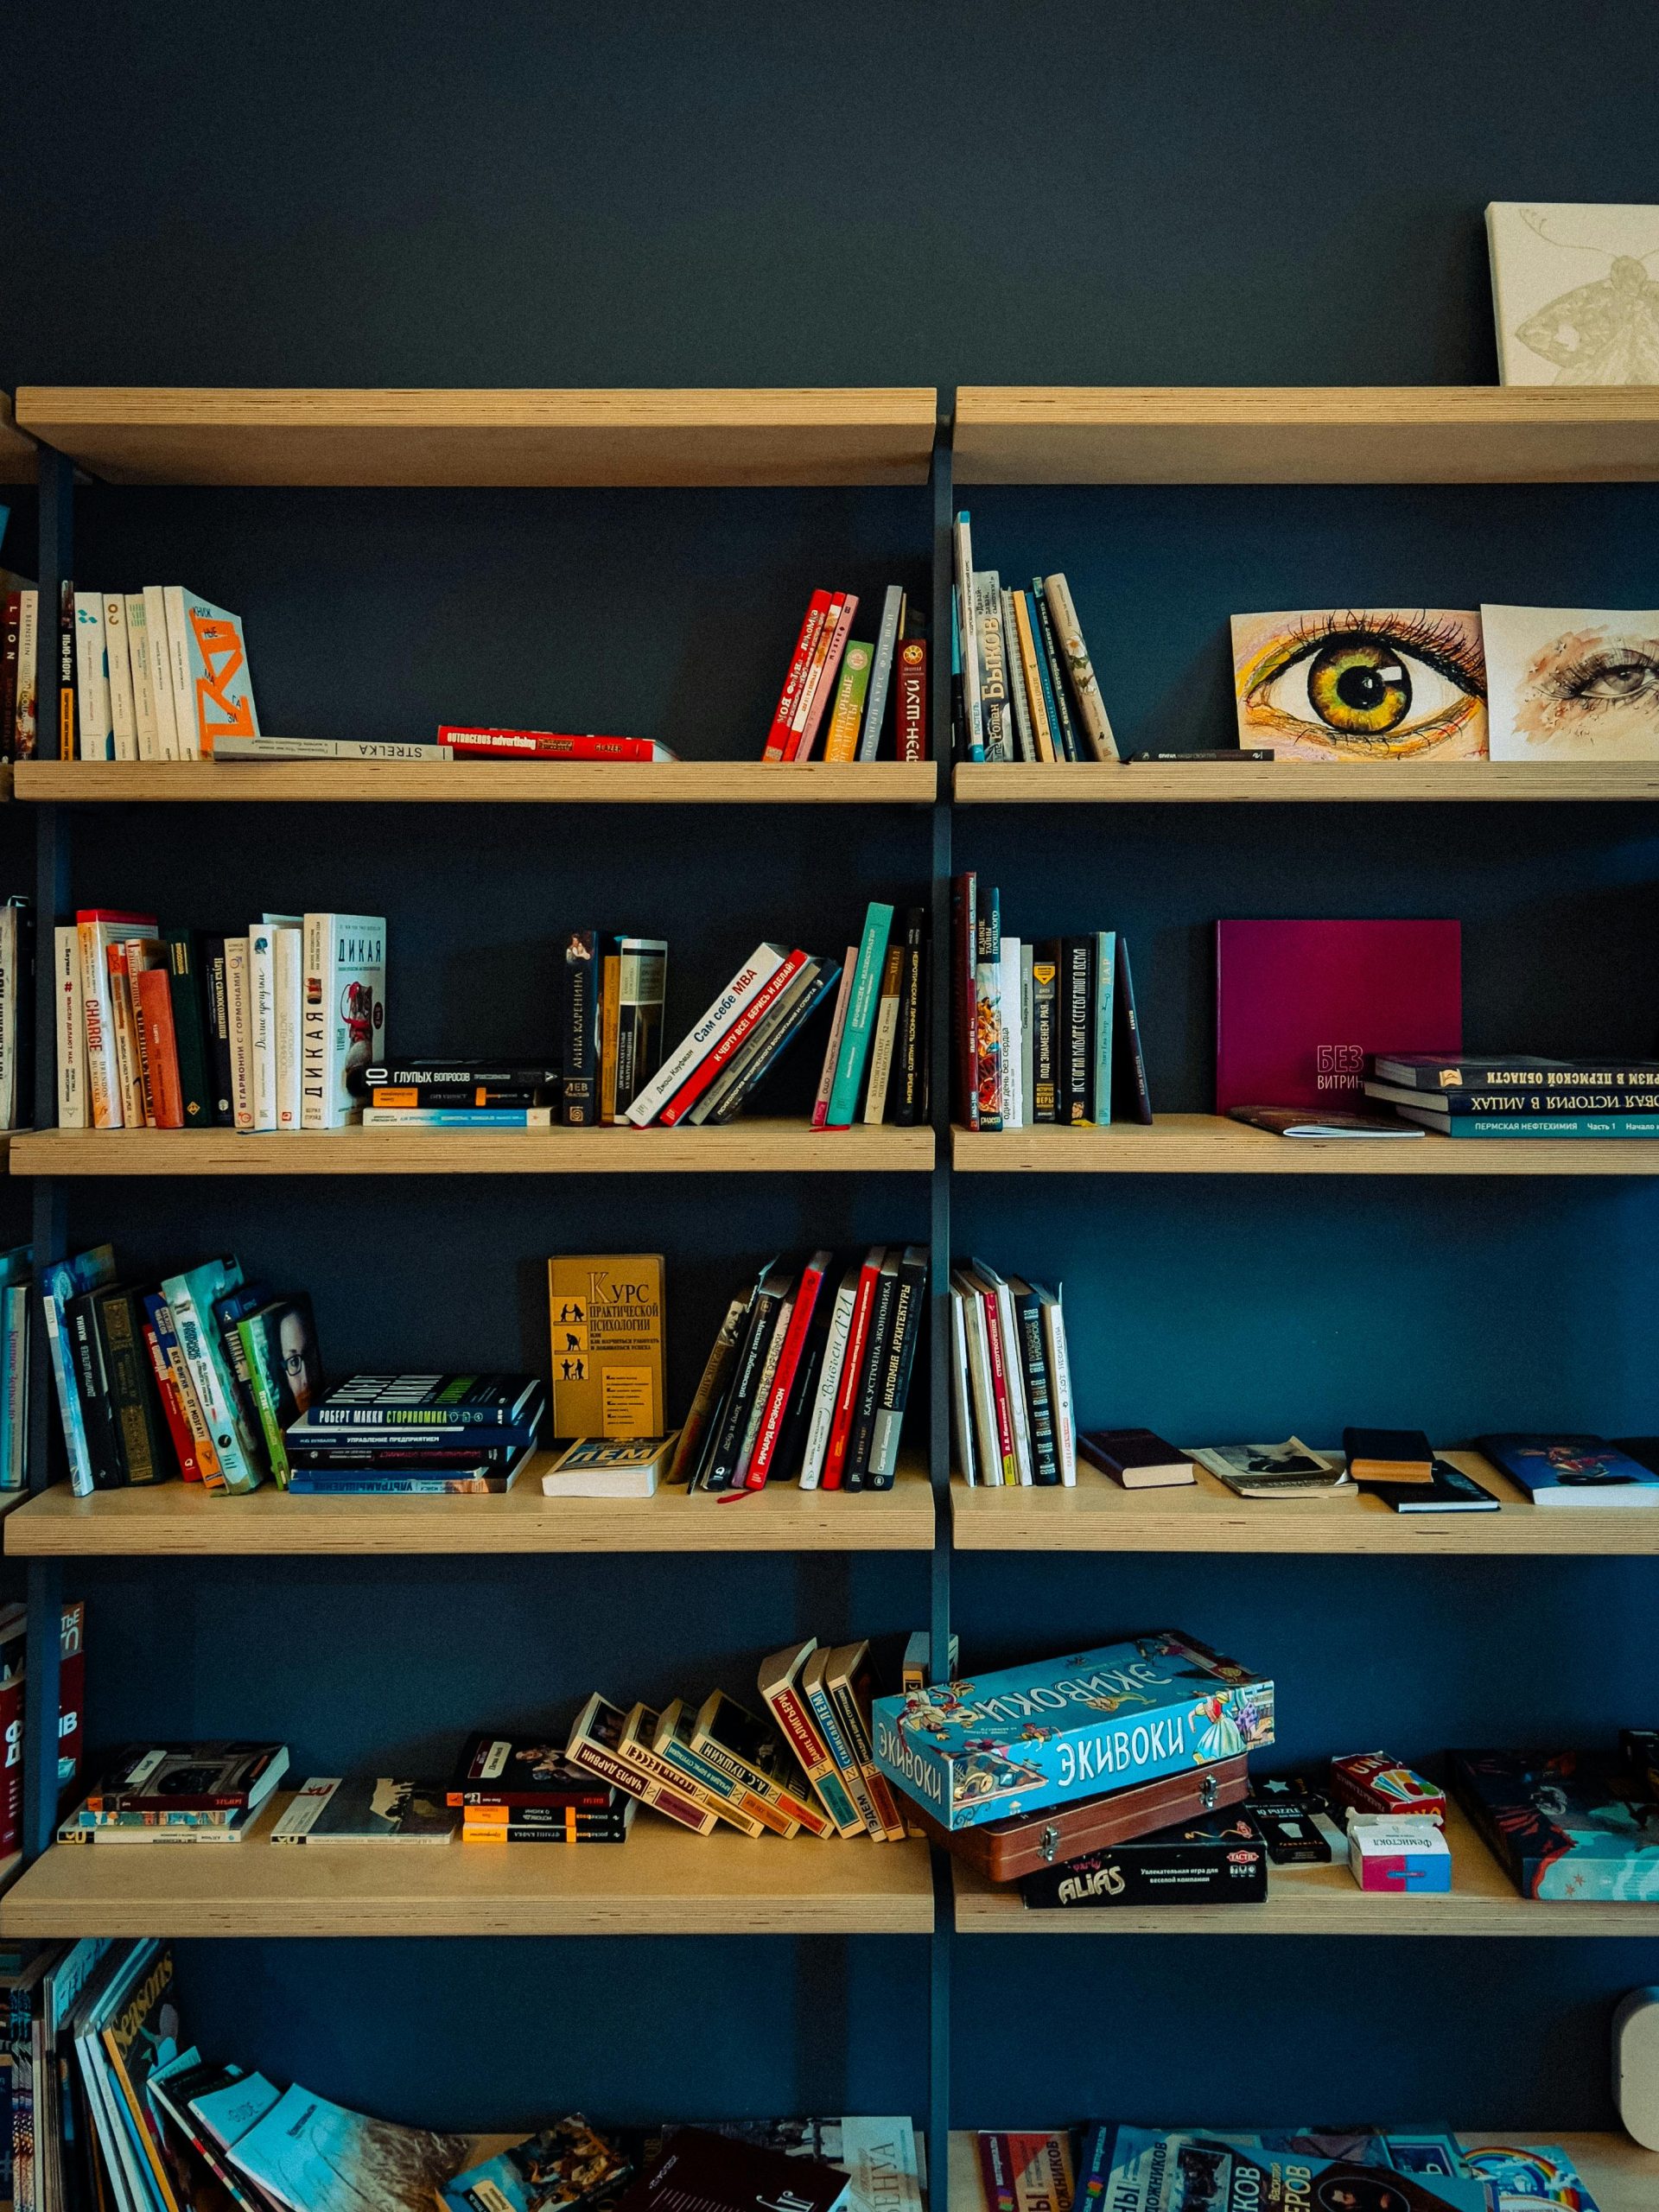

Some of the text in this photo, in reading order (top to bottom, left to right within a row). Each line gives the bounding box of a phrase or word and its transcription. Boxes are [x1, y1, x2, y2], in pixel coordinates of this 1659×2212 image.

[5, 606, 16, 659] LION
[61, 633, 71, 681] НЬЮ-ЙОРК
[878, 642, 889, 668] ФЭН
[873, 674, 885, 702] КУРС
[975, 617, 1006, 741] Ролан Быков
[830, 673, 854, 762] КУЛИНАРНЫЕ
[865, 708, 880, 756] ПОЛНЫЙ
[903, 679, 919, 762] ФЭН-ШУЙ
[972, 702, 981, 734] ПАСТЕЛЬ
[359, 743, 423, 758] STRELKA
[491, 734, 535, 750] advertising
[977, 918, 987, 954] ВЕЛИКИЕ
[990, 910, 1000, 954] ПРОШЛОГО
[338, 938, 382, 963] ДИКАЯ
[889, 949, 900, 975] ХИЛЛ
[1072, 948, 1085, 969] ВЕКА
[211, 957, 225, 981] Наука
[233, 972, 243, 1034] ГОРМОНАМИ
[717, 1032, 738, 1057] ЧЕРТУ
[733, 1017, 750, 1037] ВСЁ!
[746, 990, 771, 1021] БЕРИСЬ
[770, 959, 796, 990] ДЕЛАЙ!
[1072, 971, 1085, 1022] СЕРЕБРЯНОГО
[85, 998, 102, 1052] CHARGE
[573, 971, 582, 1068] АННА КАРЕНИНА
[693, 1018, 715, 1044] Сам
[710, 991, 737, 1022] себе
[305, 1012, 322, 1099] ДИКАЯ
[1039, 1003, 1049, 1077] ПОД ЗНАМЕНЕМ РАЯ
[237, 1046, 246, 1099] ГАРМОНИИ
[656, 1046, 694, 1095] Джош Кауфман
[822, 1039, 837, 1094] ОШО Творчество
[1000, 1027, 1011, 1119] один день без сердца
[1072, 1058, 1085, 1092] ИСТОРИЯ
[1317, 1045, 1364, 1072] БЕЗ
[91, 1058, 101, 1103] BURCHARD
[99, 1059, 108, 1097] BRENDON
[365, 1068, 388, 1086] 10
[393, 1071, 432, 1084] ГЛУПЫХ
[433, 1072, 471, 1082] ВОПРОСОВ
[565, 1083, 588, 1092] ЛЕВ
[1487, 1072, 1543, 1084] ОБЛАСТИ
[1548, 1072, 1612, 1087] ПЕРМСКОЙ
[1617, 1073, 1624, 1084] В
[1471, 1096, 1525, 1110] ЛИЦАХ
[1531, 1096, 1540, 1109] В
[1547, 1096, 1620, 1109] ИСТОРИЯ
[1475, 1122, 1520, 1131] ПЕРМСКАЯ
[1521, 1122, 1578, 1131] НЕФТЕХИМИЯ
[1587, 1122, 1611, 1131] Часть
[587, 1272, 649, 1304] КУРС
[75, 1314, 87, 1341] ЖАННА
[589, 1303, 659, 1318] ПРАКТИЧЕСКОЙ
[590, 1319, 651, 1332] ПСИХОЛОГИИ
[171, 1350, 181, 1364] ВСЯ
[862, 1280, 892, 1415] КАК УСТРОЕНА ЭКОНОМИКА
[881, 1283, 912, 1408] АНАТОМИЯ АРХИТЕКТУРЫ
[1030, 1319, 1042, 1361] НАБОКОВ
[734, 1319, 767, 1398] Михаил Лабковский
[753, 1332, 783, 1411] БАЛЕТНЫЕ ТУФЕЛЬКИ
[175, 1364, 189, 1389] ФИГНЯ
[187, 1398, 195, 1408] ОТ
[319, 1410, 448, 1423] РОБЕРТ МАККИ СТОРИНОМИКА
[729, 1403, 743, 1424] Хочу
[721, 1432, 734, 1452] буду
[757, 1387, 785, 1465] РИЧАРД БРЭНСОН
[566, 1449, 653, 1465] ЛЕМ
[313, 1482, 411, 1491] УЛЬТРАМЫШЛЕНИЕ
[976, 1662, 1173, 1723] ЭКИВОКИ
[776, 1693, 822, 1762] ДАНТЕ АЛИГЬЕРИ
[811, 1694, 851, 1764] СТАНИСЛАВ ЛЕМ
[580, 1748, 642, 1789] ЧАРЛЗ ДАРВИН
[702, 1745, 766, 1792] А.С. ПУШКИН
[879, 1722, 943, 1805] ЭКИВОКИ
[1056, 1716, 1185, 1788] ЭКИВОКИ
[630, 1751, 693, 1790] ГЕРМАН ГЕССЕ
[855, 1793, 880, 1828] ЭДЕМ
[1373, 1839, 1433, 1848] Фемистокл
[1073, 1859, 1102, 1872] party
[1141, 1868, 1189, 1877] Увлекательная
[1268, 2162, 1283, 2202] Василий
